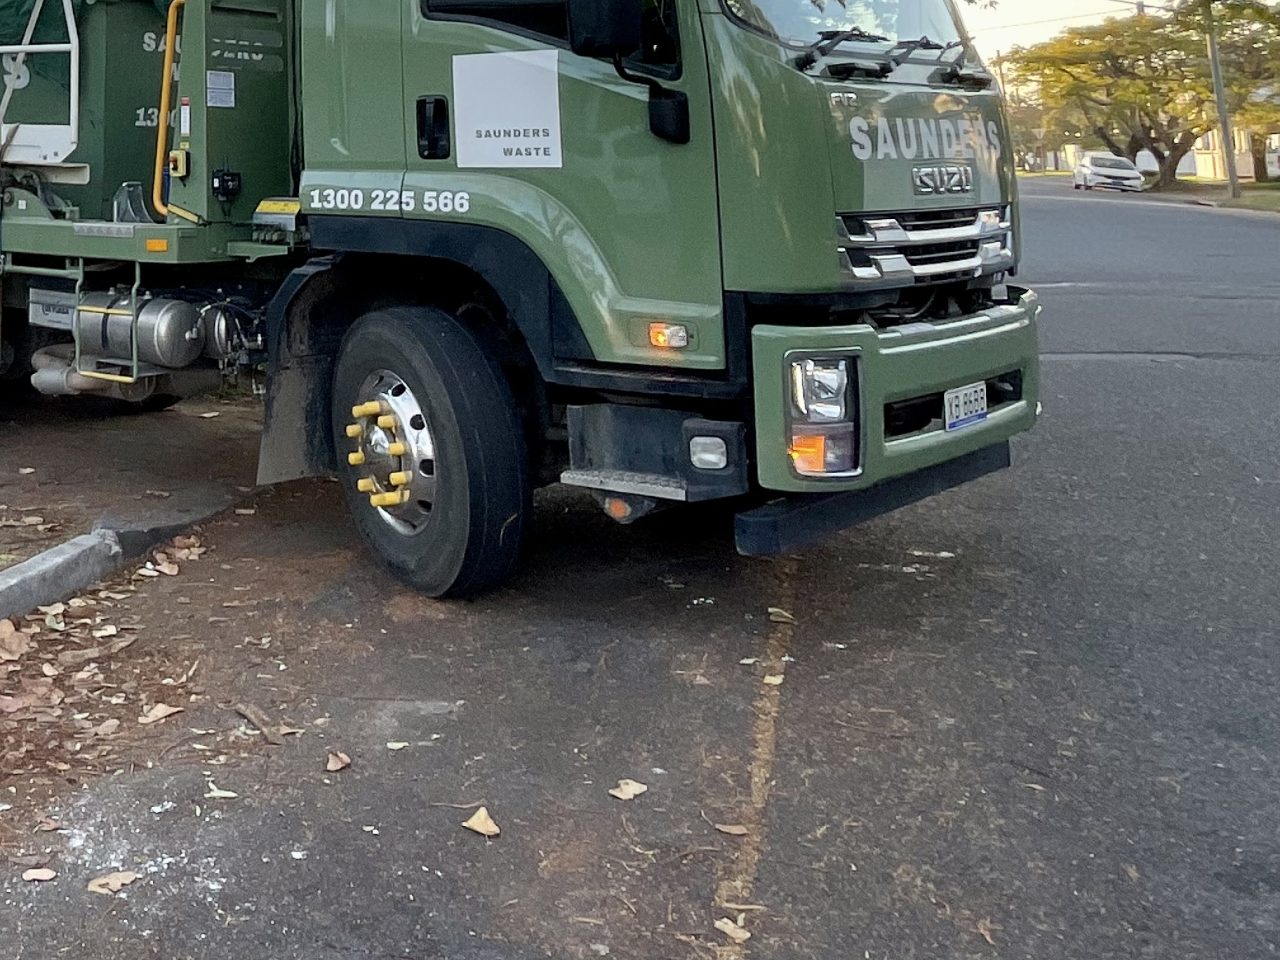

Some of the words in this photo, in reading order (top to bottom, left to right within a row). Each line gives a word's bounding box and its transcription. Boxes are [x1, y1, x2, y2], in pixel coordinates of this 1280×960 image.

[475, 127, 551, 139] SAUNDERS
[849, 115, 1001, 160] SAUNDERS
[502, 146, 552, 157] WASTE
[911, 166, 973, 195] ISUZU
[309, 189, 364, 209] 1300
[370, 189, 415, 211] 225
[423, 191, 470, 213] 566
